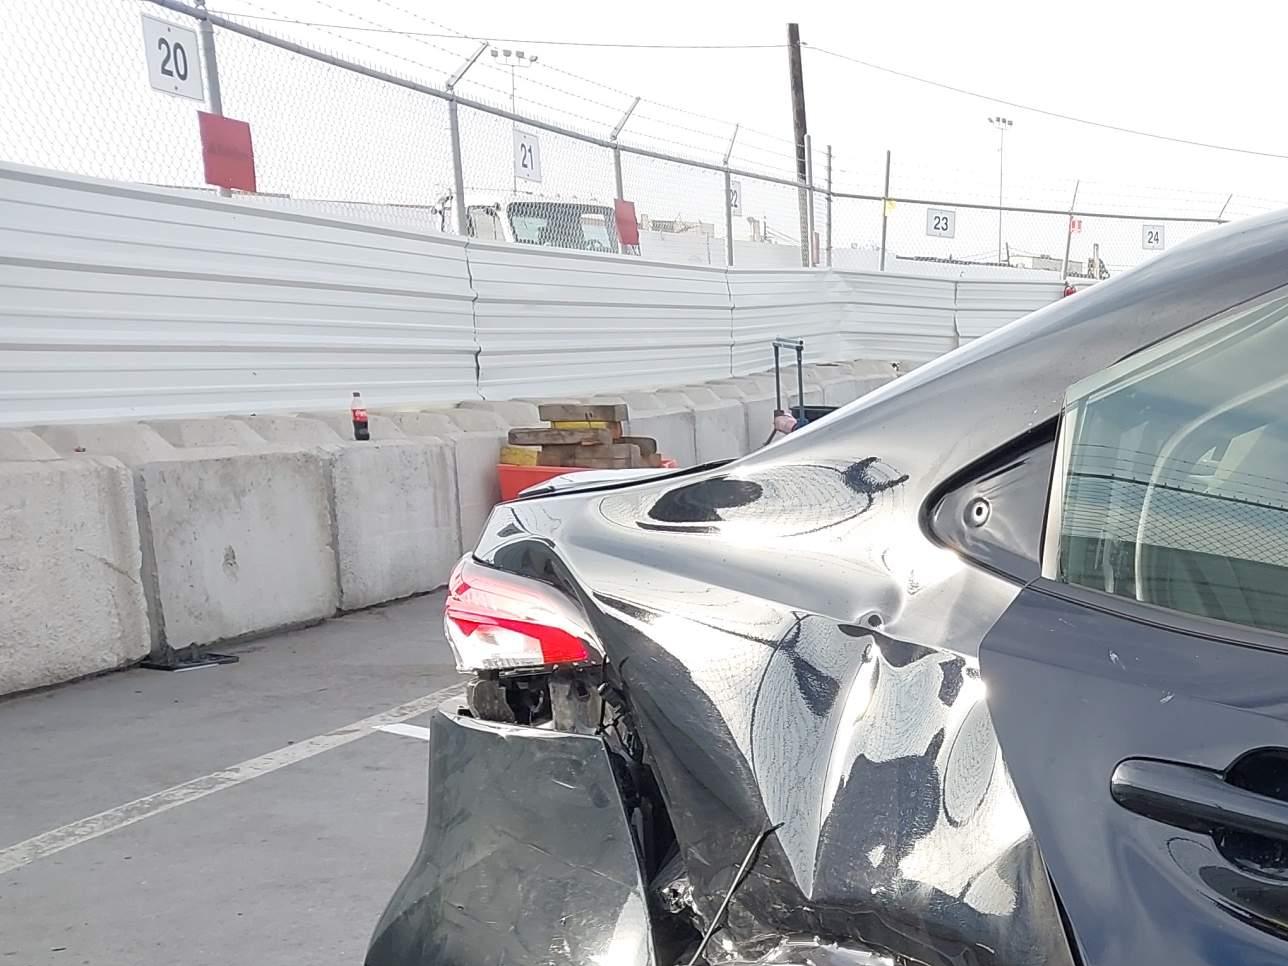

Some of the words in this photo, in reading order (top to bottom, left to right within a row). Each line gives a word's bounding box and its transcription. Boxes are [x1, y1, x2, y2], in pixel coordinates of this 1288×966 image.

[158, 37, 188, 81] 20
[520, 143, 534, 170] 21
[934, 215, 949, 231] 23
[1147, 230, 1160, 245] 24
